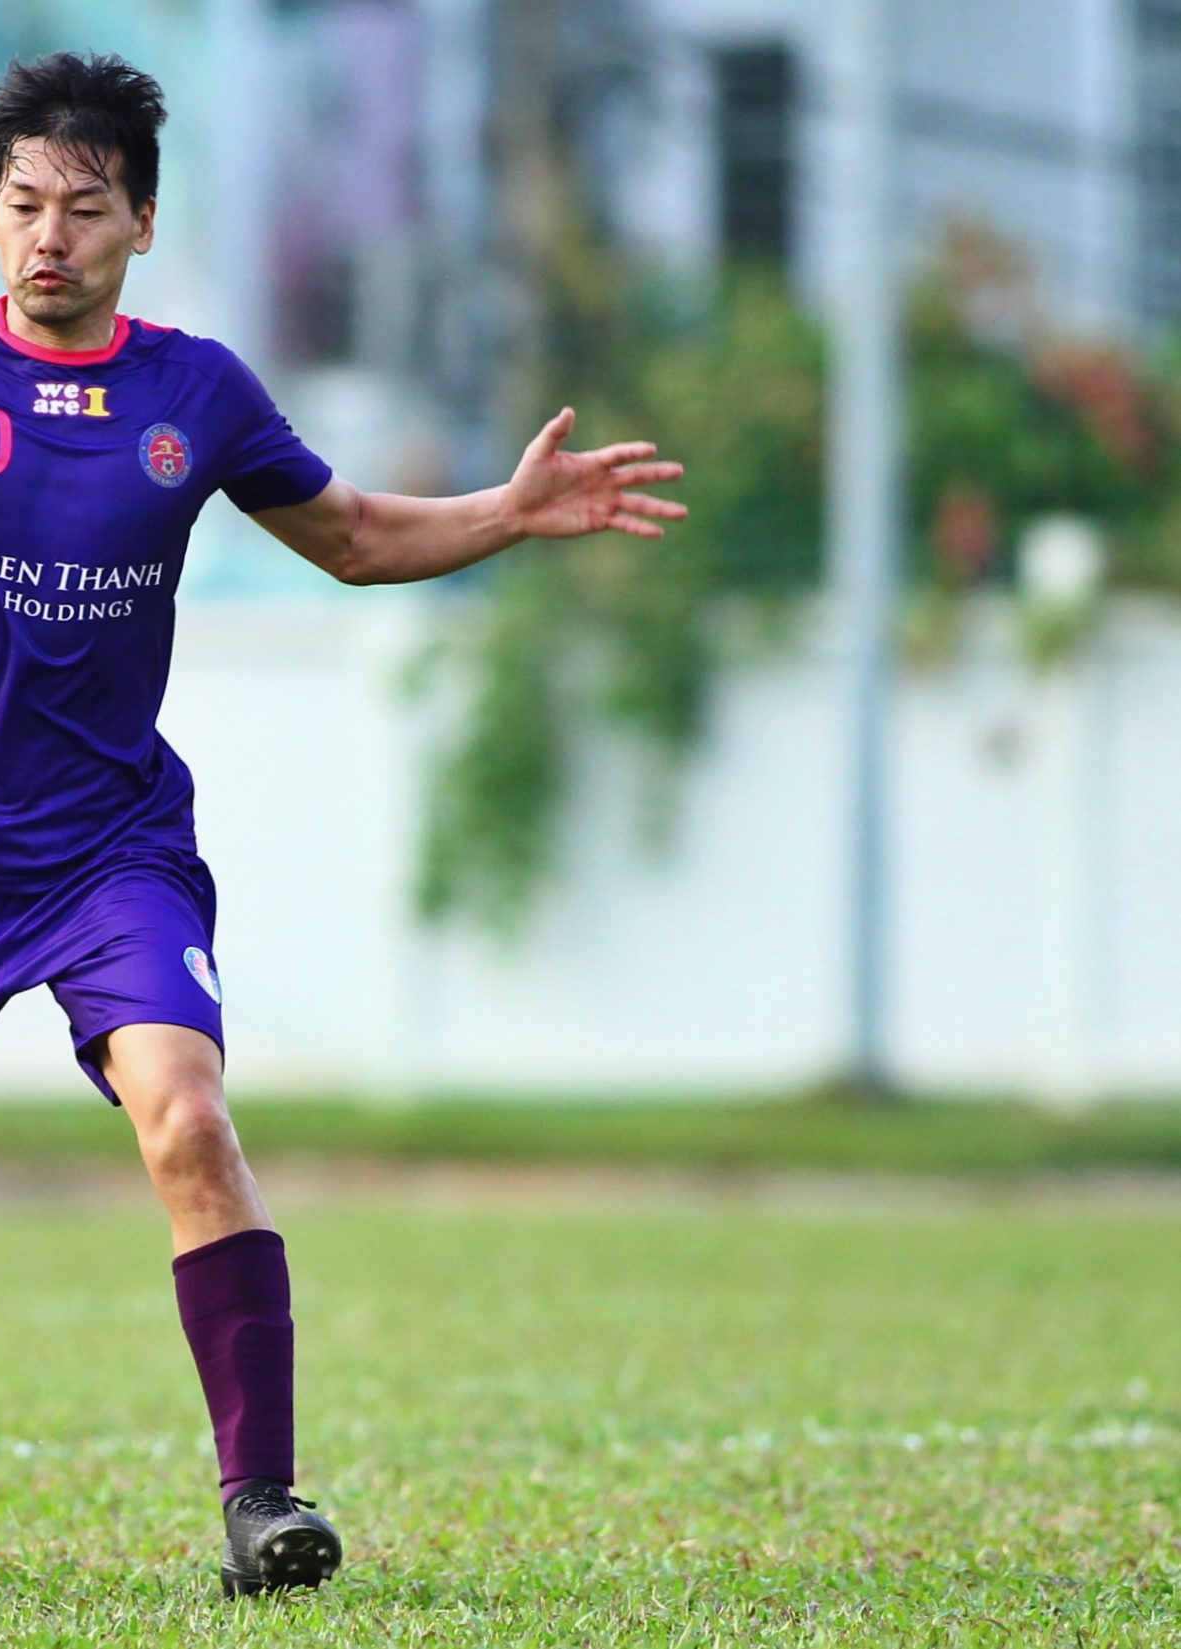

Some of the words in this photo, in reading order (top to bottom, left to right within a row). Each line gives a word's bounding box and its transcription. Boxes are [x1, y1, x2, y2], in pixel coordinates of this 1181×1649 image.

[32, 399, 80, 415] are
[82, 387, 111, 417] 1
[35, 383, 80, 399] we
[54, 562, 163, 591] THANH
[4, 590, 134, 622] HOLDINGS
